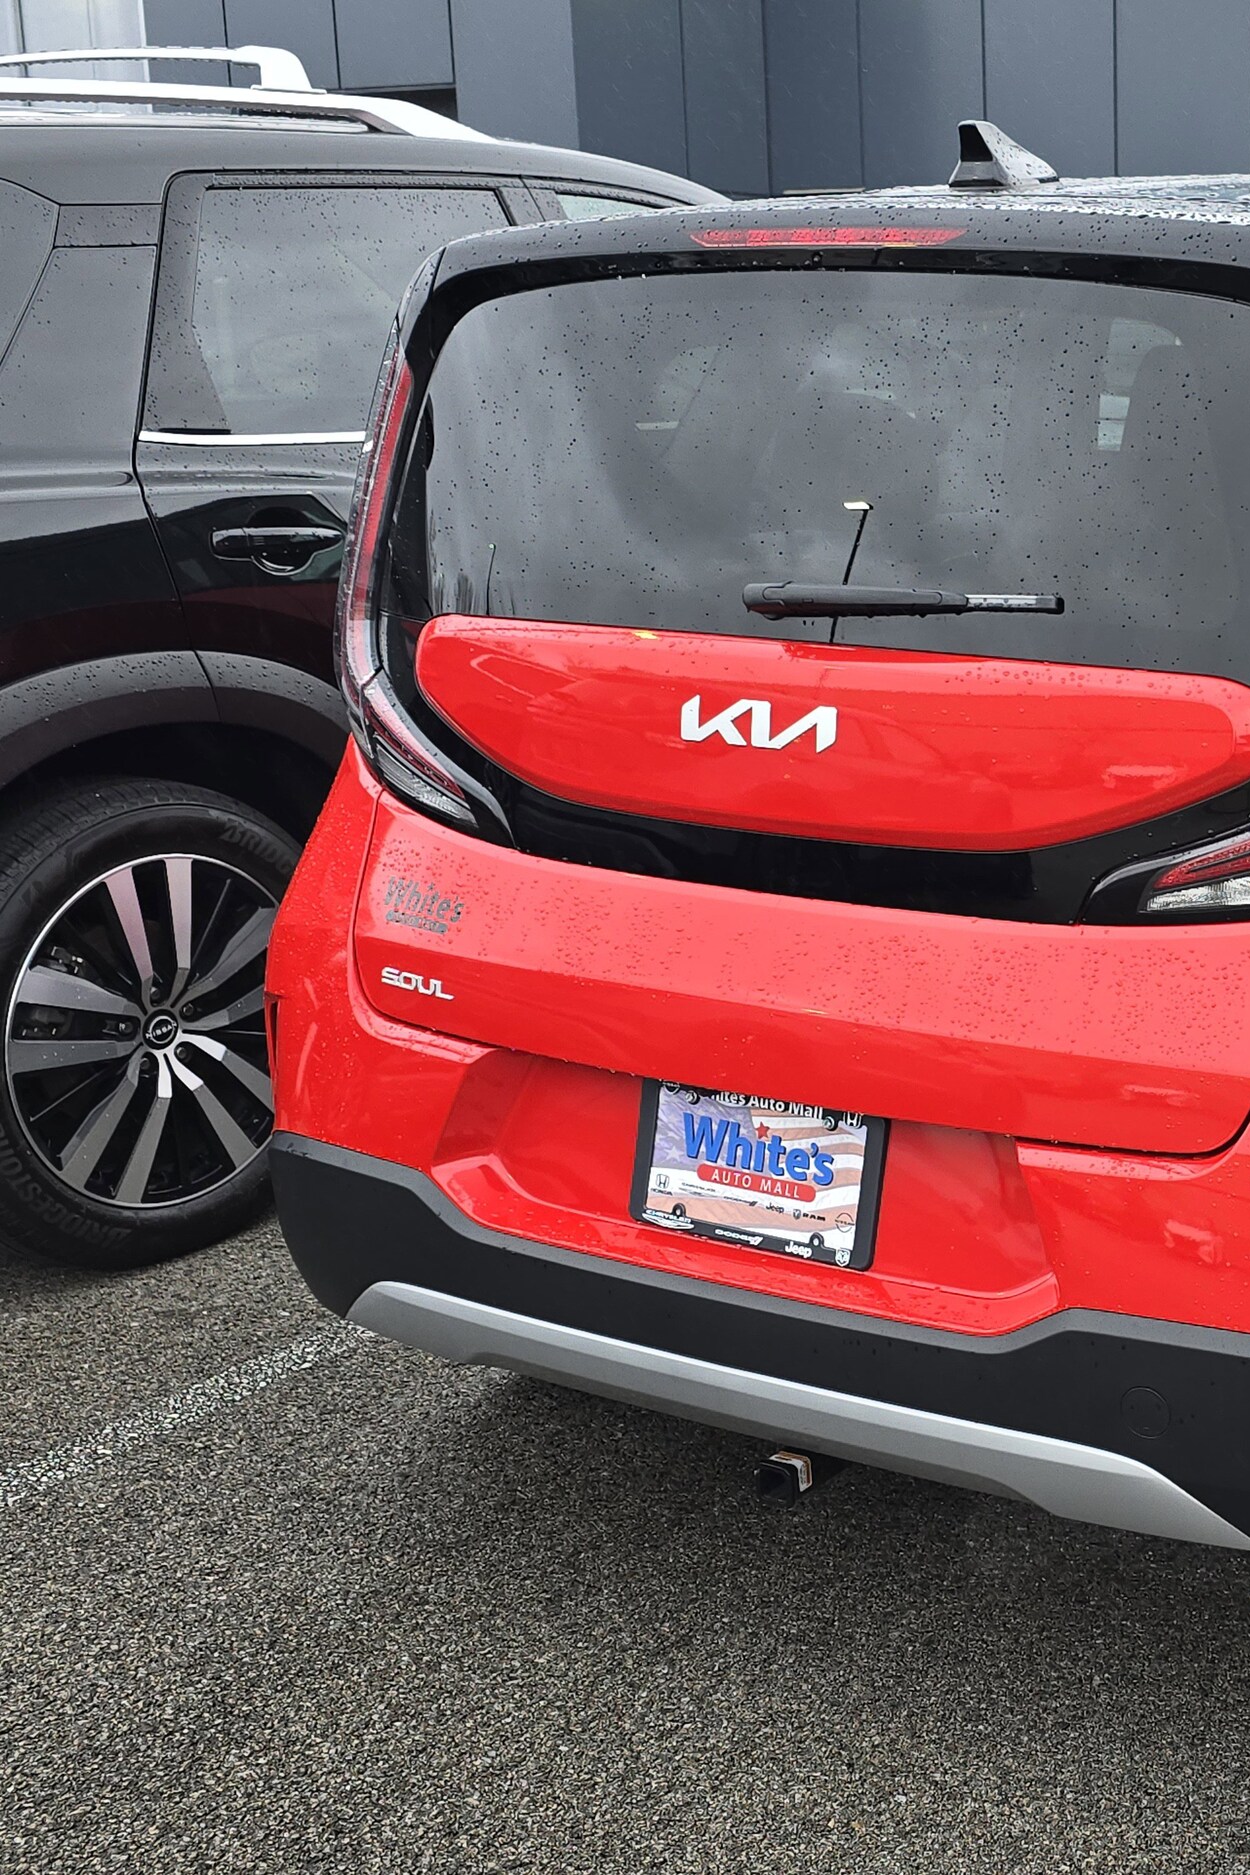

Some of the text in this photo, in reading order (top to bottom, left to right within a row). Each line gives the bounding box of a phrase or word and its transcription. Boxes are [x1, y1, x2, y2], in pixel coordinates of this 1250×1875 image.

[680, 694, 838, 754] KIA
[384, 876, 466, 923] White's
[381, 966, 455, 1001] SOUL
[748, 1095, 785, 1112] Auto
[788, 1101, 823, 1120] Mall
[682, 1111, 835, 1187] White's
[711, 1168, 800, 1199] AUTO MALL
[765, 1201, 785, 1214] Jeep
[802, 1212, 826, 1222] RAM
[784, 1240, 812, 1258] Jeep
